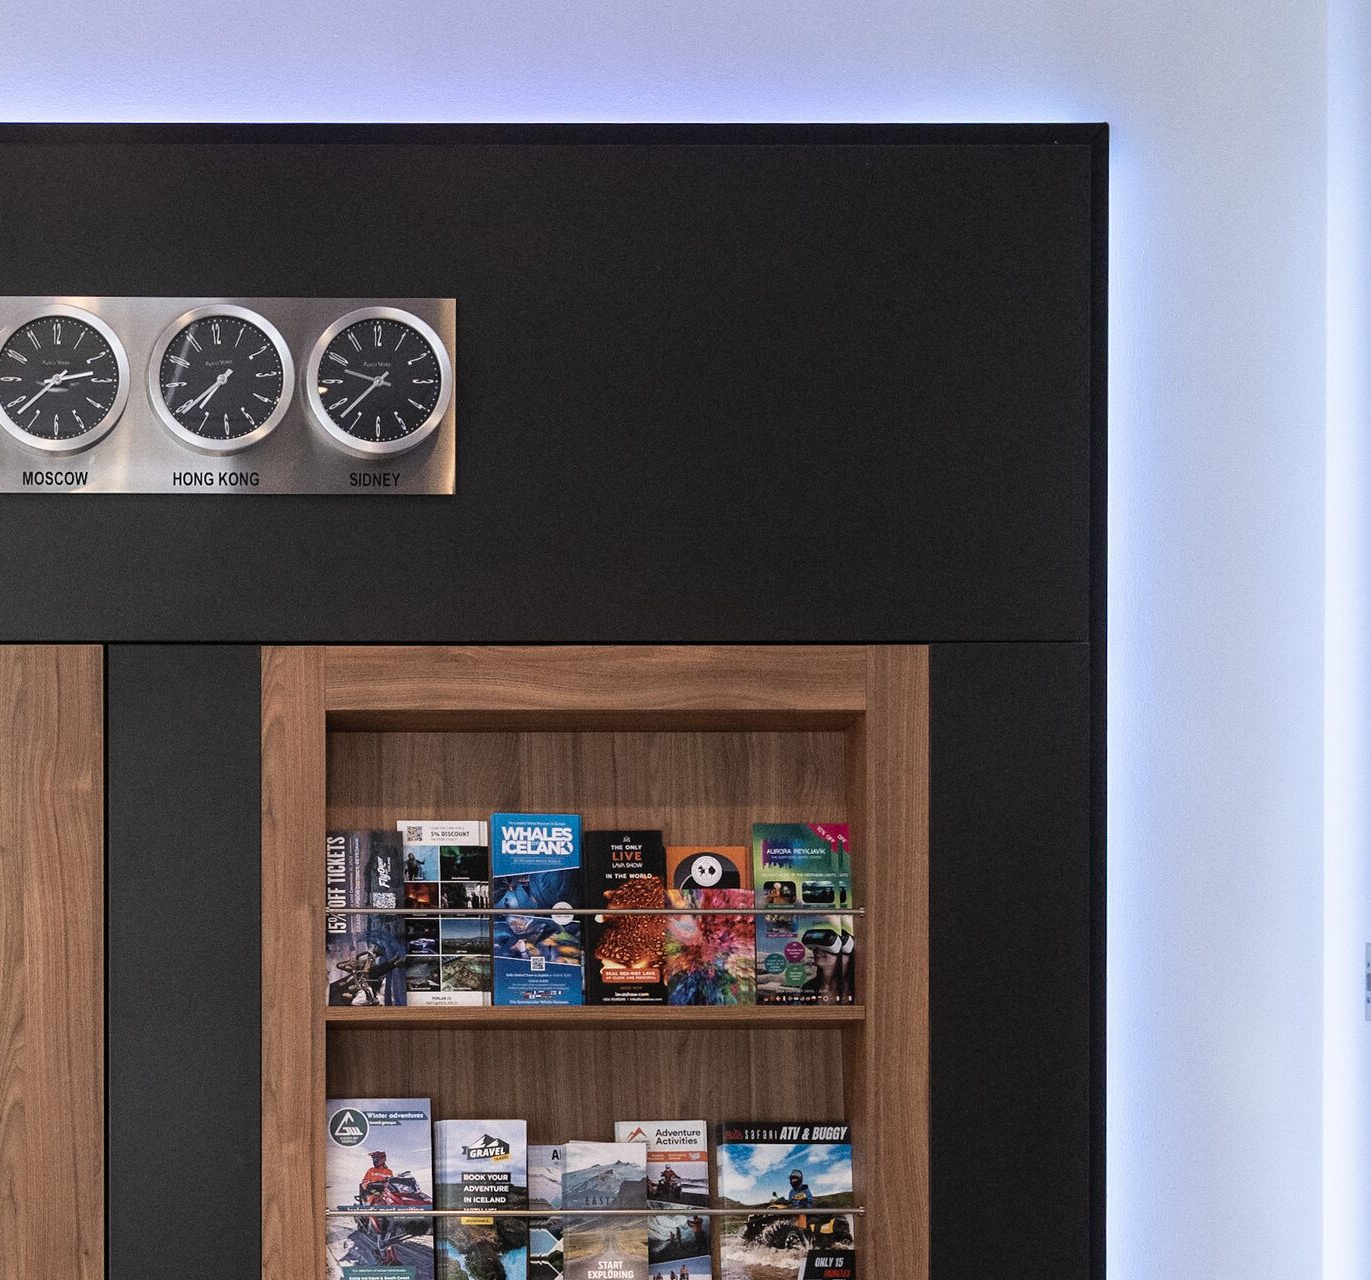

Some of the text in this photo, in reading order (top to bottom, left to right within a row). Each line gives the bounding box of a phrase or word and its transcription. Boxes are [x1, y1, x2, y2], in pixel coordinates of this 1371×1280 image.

[53, 324, 61, 344] 12
[211, 324, 221, 344] 12
[375, 326, 382, 346] 12
[8, 349, 27, 363] 10
[169, 355, 190, 368] 10
[329, 352, 348, 366] 10
[22, 472, 88, 486] MOSCOW
[173, 472, 260, 486] HONG KONG
[350, 473, 401, 487] SIDNEY
[501, 826, 573, 841] WHALES
[501, 840, 574, 855] ICELAND
[326, 836, 346, 885] TICKETS
[612, 852, 642, 861] LIVE
[327, 887, 347, 908] OFF
[656, 1129, 701, 1137] Adventure
[780, 1127, 800, 1140] ATV
[802, 1128, 810, 1140] &
[812, 1127, 848, 1140] BUGGY
[470, 1147, 505, 1158] GRAVEL
[598, 1261, 623, 1269] START
[815, 1257, 844, 1267] ONLY 15
[588, 1270, 634, 1279] EXPLORING
